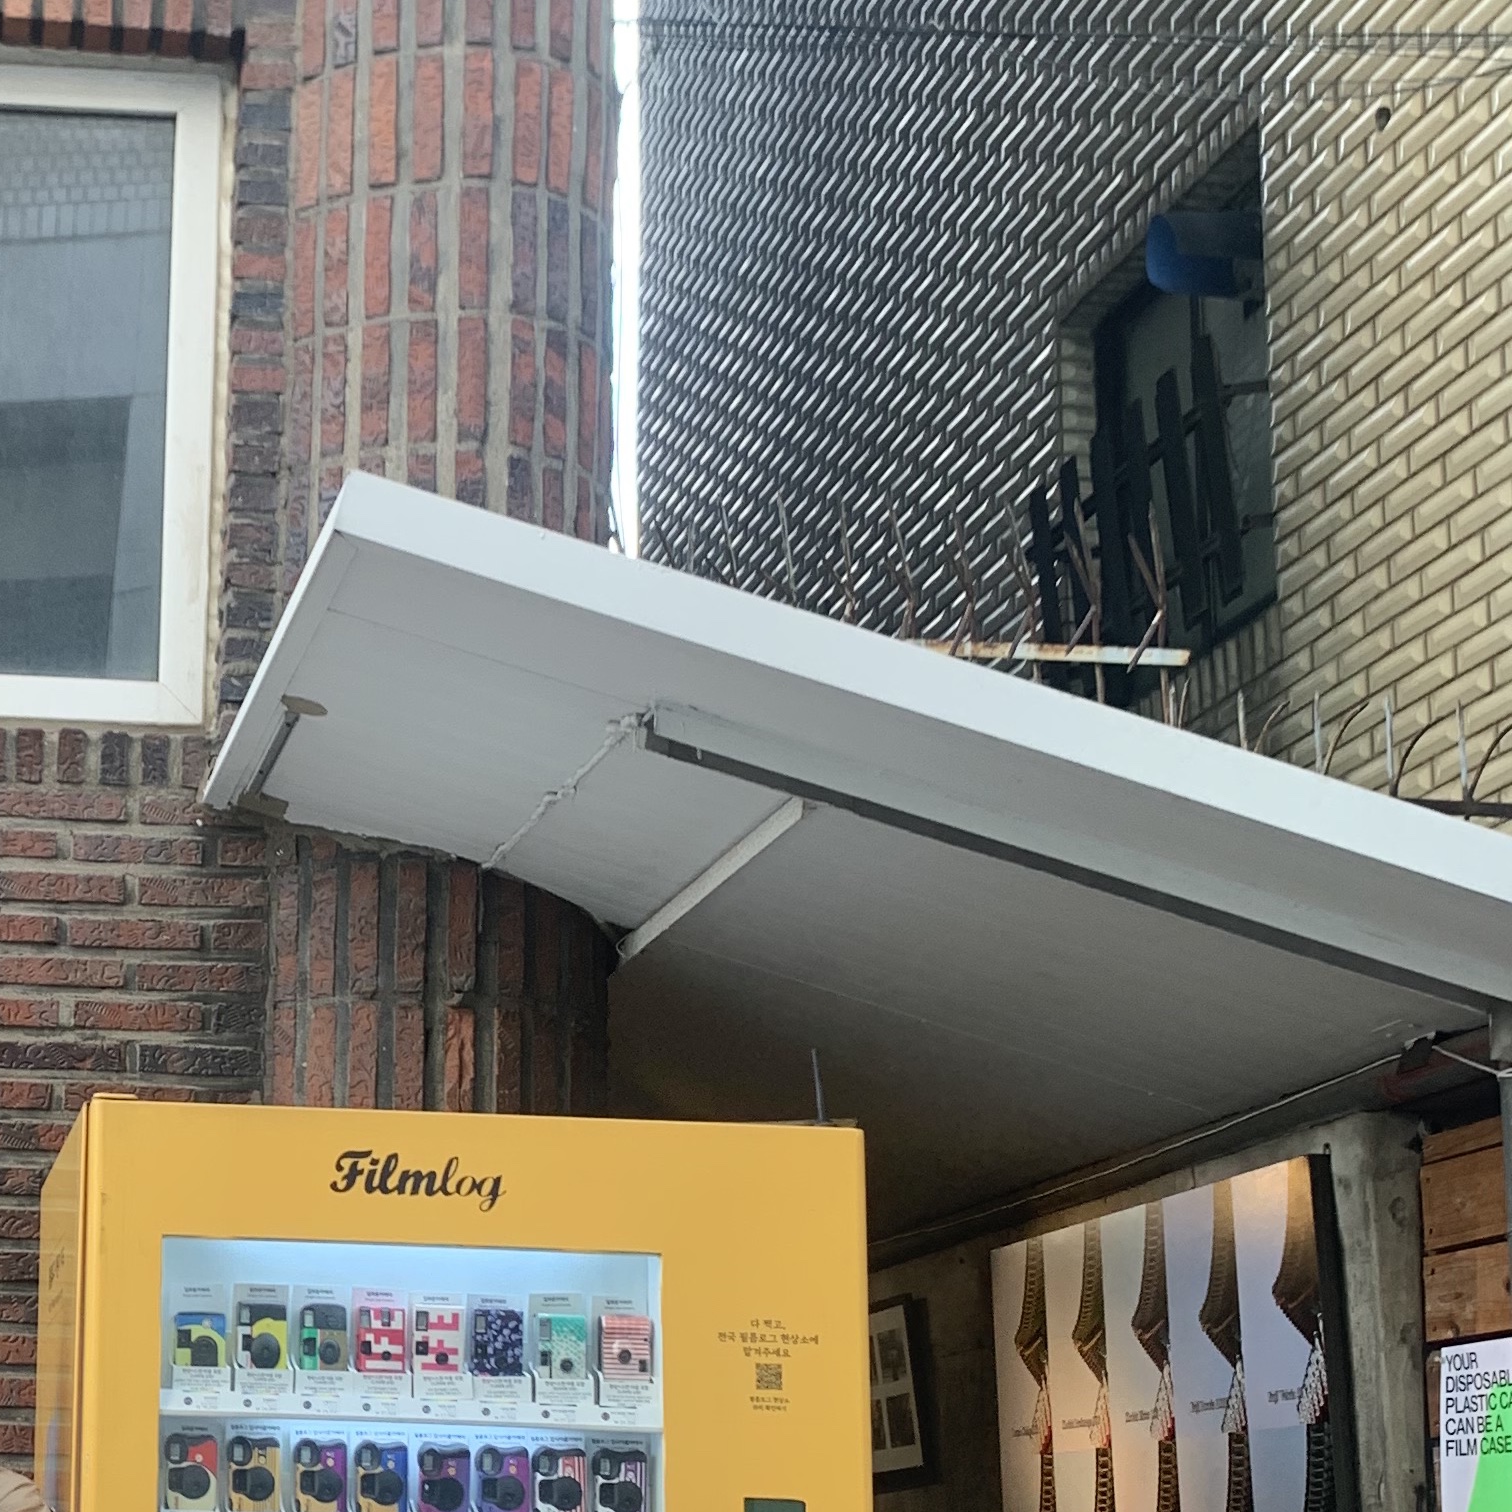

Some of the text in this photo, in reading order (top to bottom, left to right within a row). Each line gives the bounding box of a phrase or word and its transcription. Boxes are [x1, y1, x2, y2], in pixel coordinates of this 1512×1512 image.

[330, 1150, 506, 1213] Filmlog
[750, 1318, 760, 1329] 다
[718, 1331, 736, 1342] 전국
[739, 1332, 778, 1343] 필름로그
[1445, 1351, 1478, 1372] YOUR
[1445, 1392, 1497, 1414] PLASTIC
[1445, 1414, 1504, 1435] CAN BE A
[1445, 1435, 1512, 1457] FILM CASE
